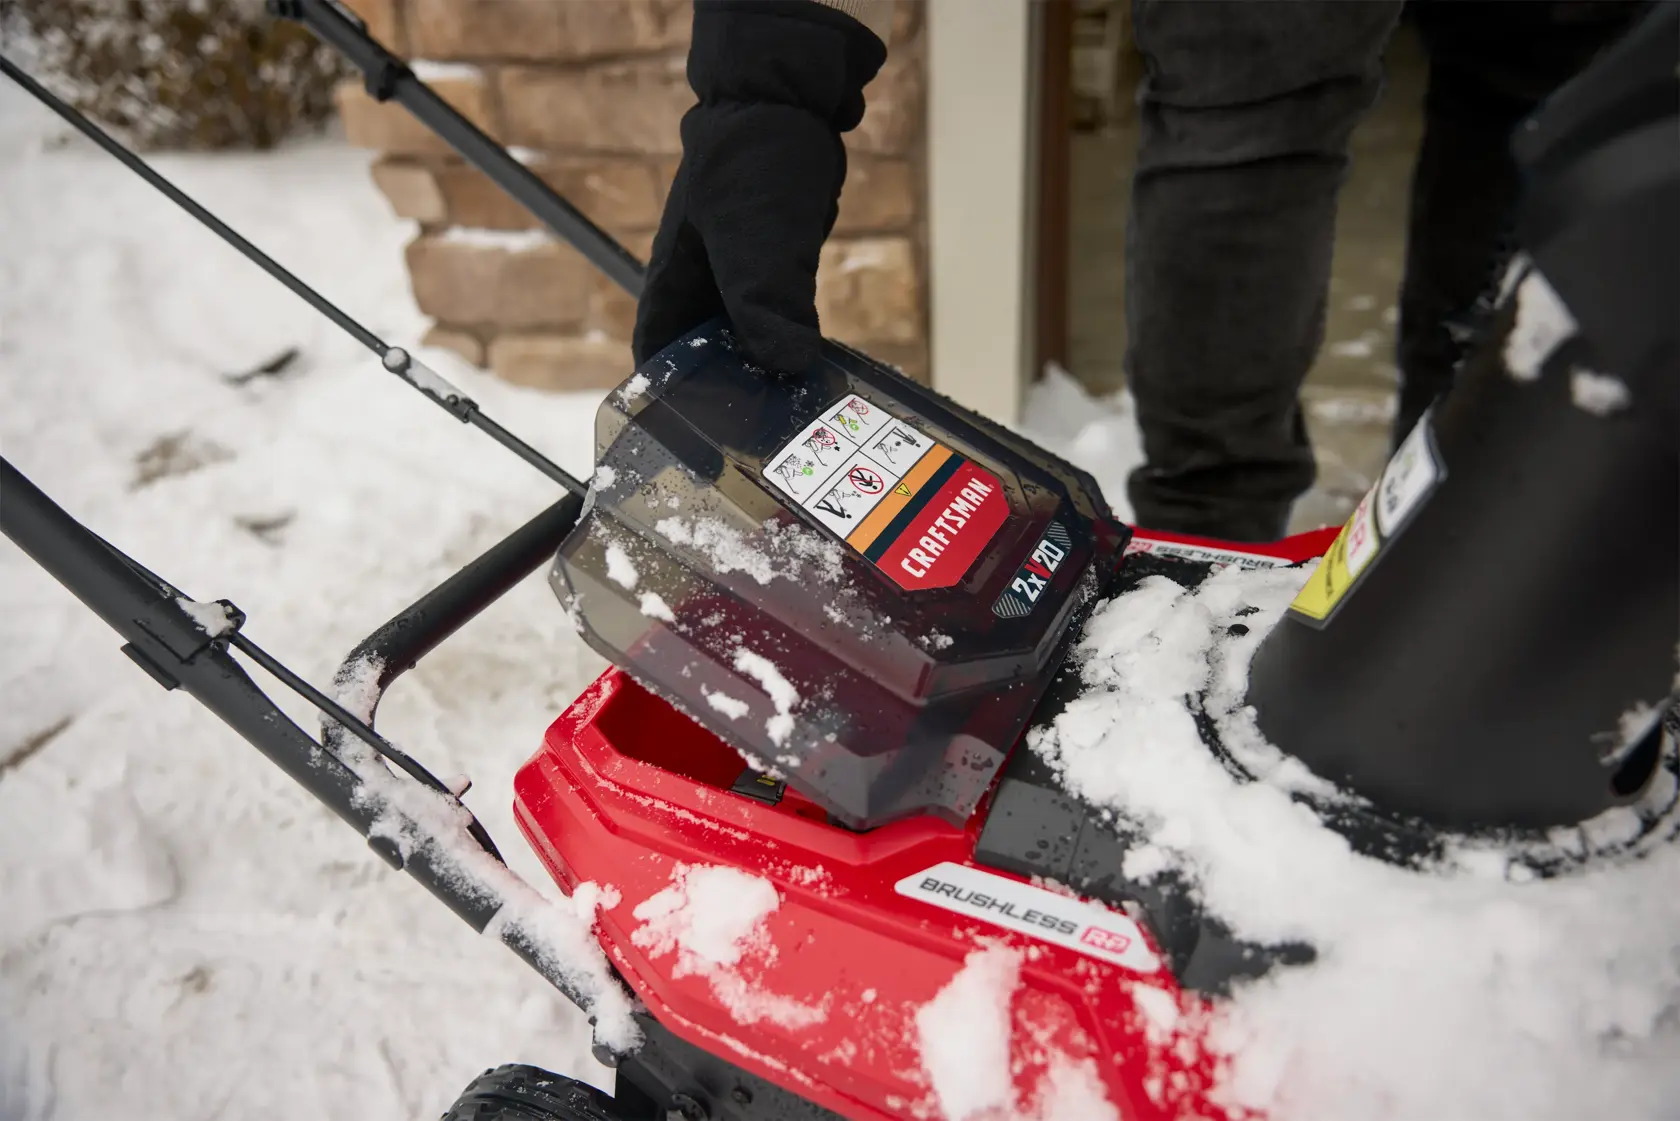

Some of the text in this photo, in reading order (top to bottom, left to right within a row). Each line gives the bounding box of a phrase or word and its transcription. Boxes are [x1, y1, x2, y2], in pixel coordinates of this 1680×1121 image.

[901, 478, 993, 578] CRAFTSMAN
[1156, 545, 1275, 570] BRUSHLESS
[919, 877, 1079, 935] BRUSHLESS
